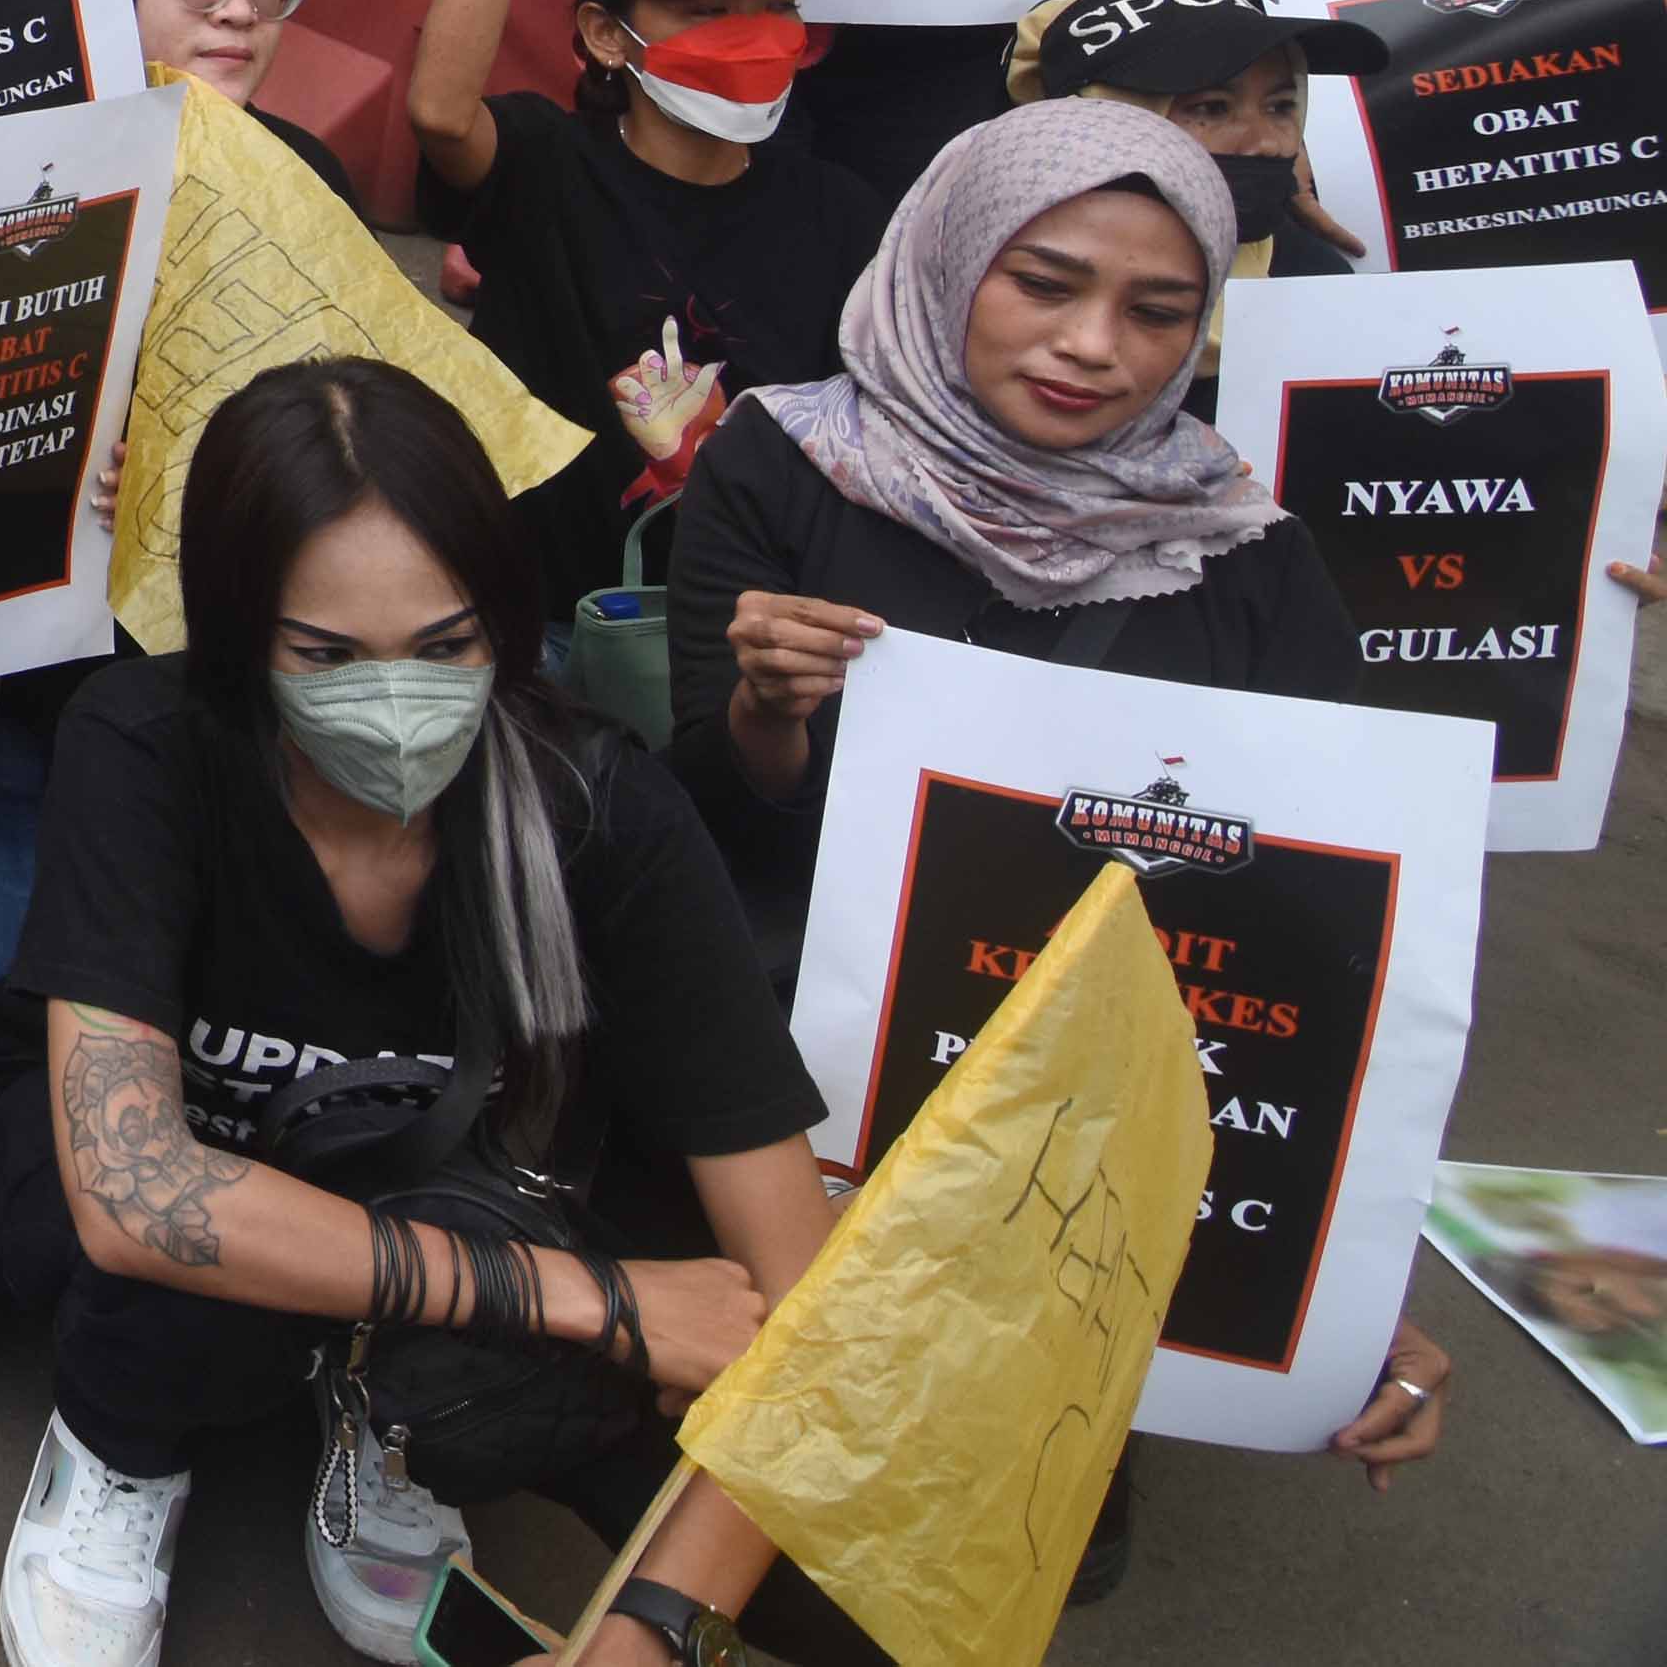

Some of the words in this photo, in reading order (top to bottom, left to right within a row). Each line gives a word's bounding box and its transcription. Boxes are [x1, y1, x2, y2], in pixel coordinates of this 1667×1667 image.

[23, 16, 47, 43] C
[1412, 43, 1621, 98] SEDIAKAN
[1472, 99, 1580, 136] OBAT
[1413, 142, 1621, 192] HEPATITIS
[1631, 135, 1660, 159] C
[1404, 190, 1667, 239] BERKESINAMBUNGA
[15, 275, 106, 322] BUTUH
[70, 351, 88, 379] C
[1389, 371, 1505, 397] KOMUNITAS
[1341, 478, 1535, 515] NYAWA
[1397, 553, 1465, 589] VS
[1359, 625, 1560, 662] GULASI
[1072, 798, 1243, 854] KOMUNITAS
[1230, 1199, 1273, 1231] C
